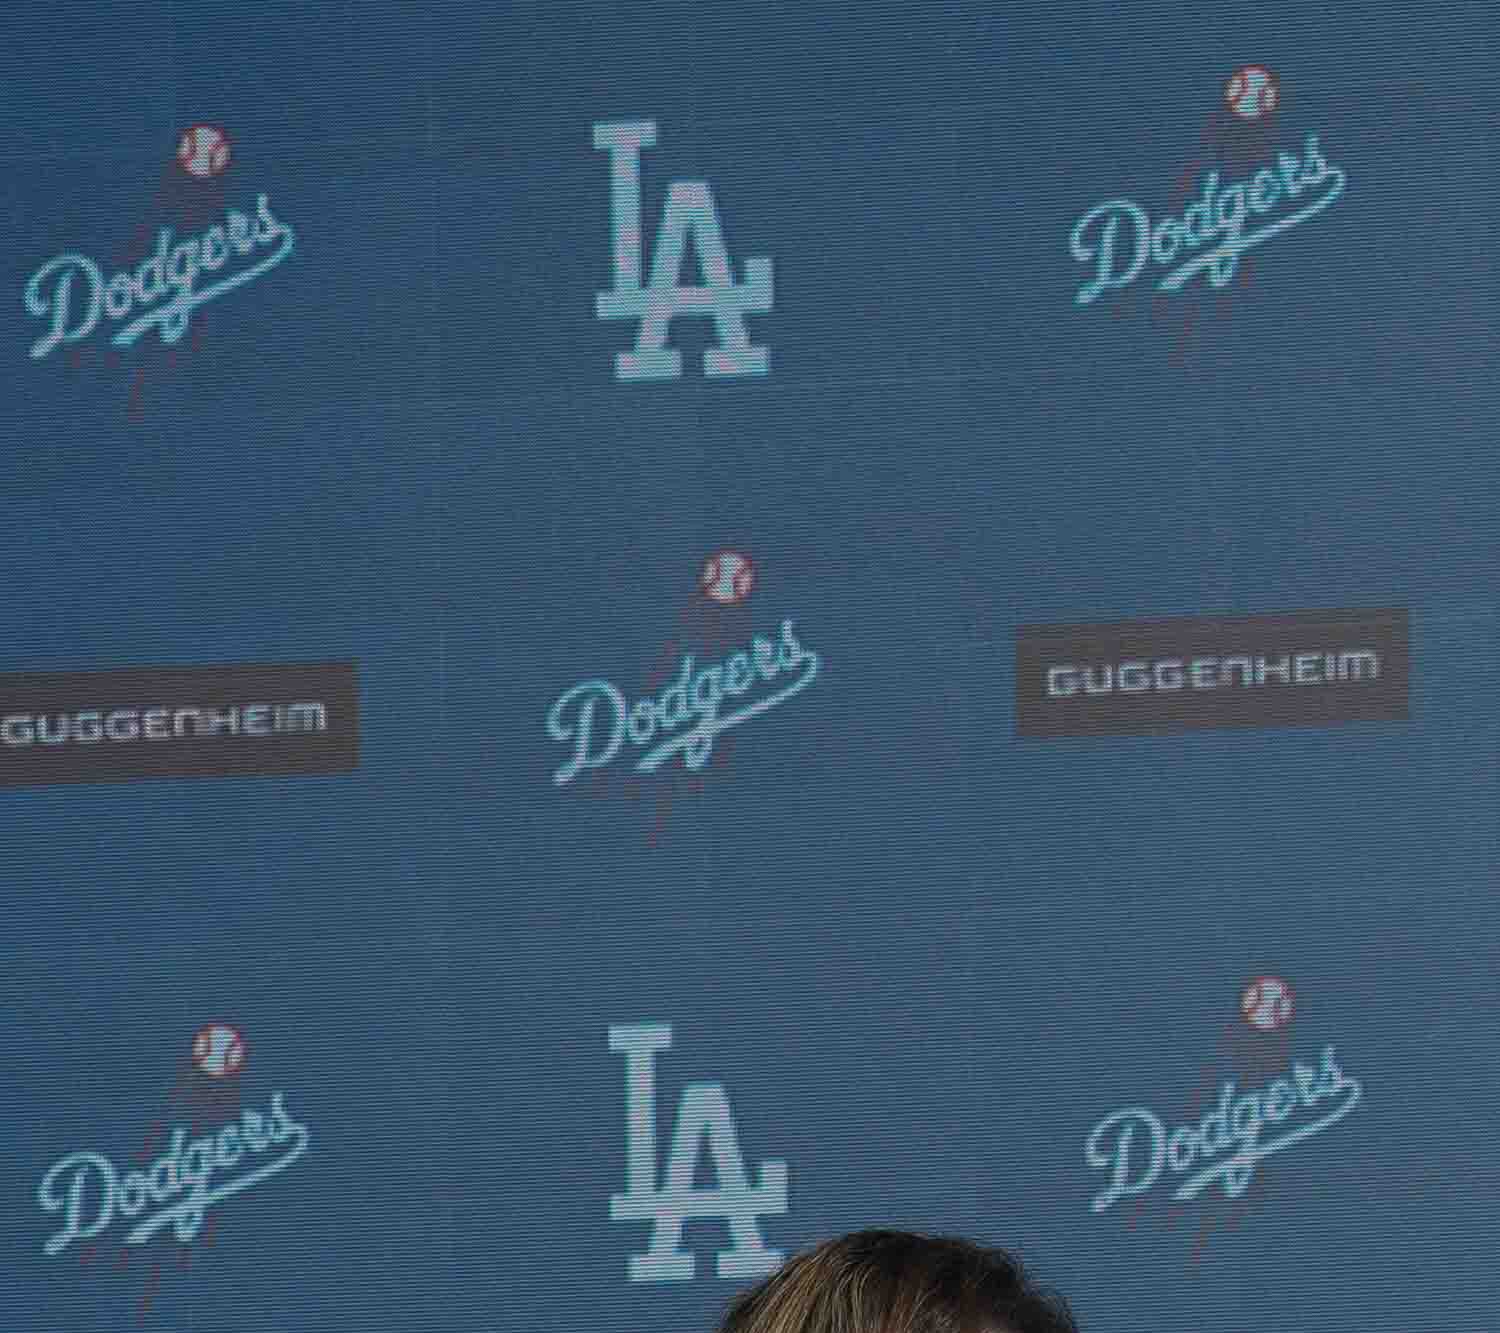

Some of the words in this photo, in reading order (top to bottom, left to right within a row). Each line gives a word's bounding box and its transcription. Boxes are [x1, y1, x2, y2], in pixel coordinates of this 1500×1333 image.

[25, 194, 296, 360] Dodgers
[592, 121, 775, 381] LA
[1070, 133, 1346, 304] Dodgers
[0, 701, 327, 746] GUGGENHEIM
[546, 619, 818, 786] Dodgers
[1047, 648, 1383, 697] GUGGENHEIM
[39, 1093, 310, 1256] Dodgers
[608, 1023, 788, 1282] LA
[1086, 1044, 1362, 1213] Dodgers
